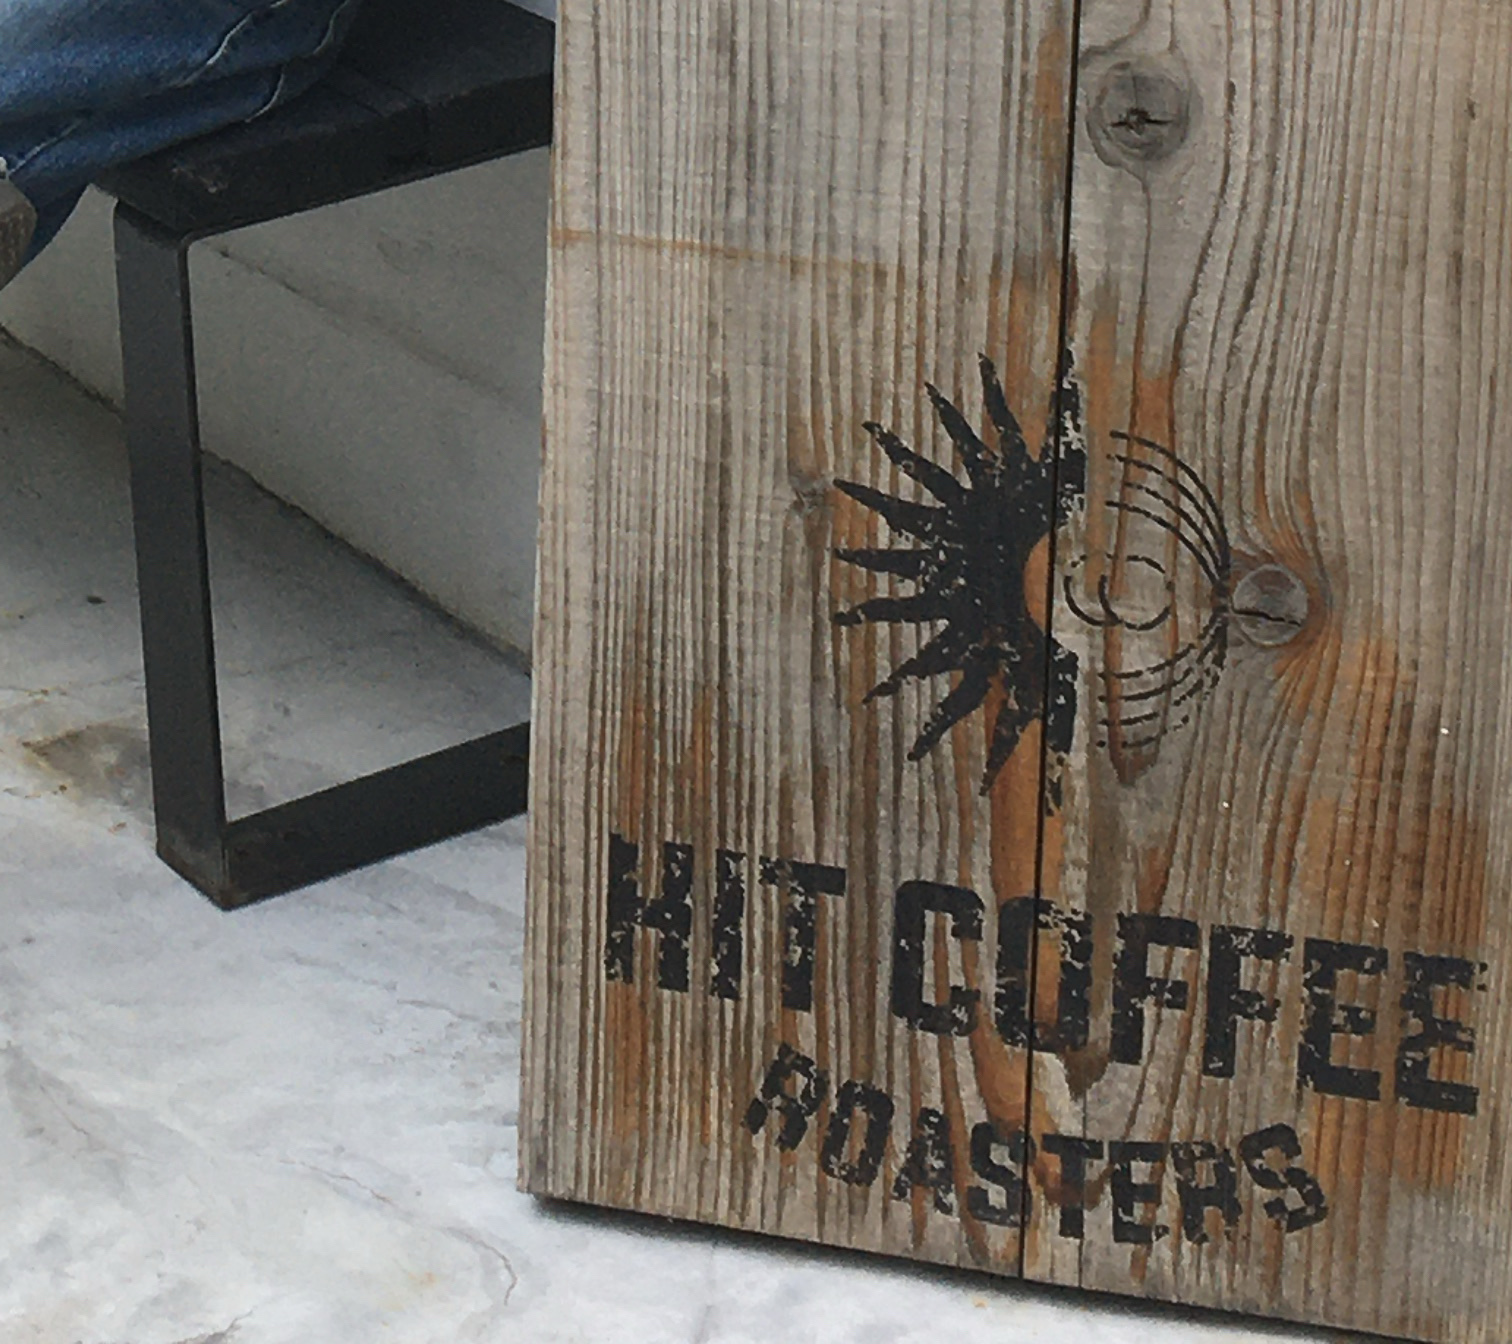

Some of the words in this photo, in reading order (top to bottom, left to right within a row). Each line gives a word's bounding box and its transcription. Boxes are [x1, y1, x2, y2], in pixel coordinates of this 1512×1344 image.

[604, 831, 847, 1012] HIT
[892, 878, 1488, 1117] COFFEE
[741, 1042, 1330, 1246] ROASTERS
